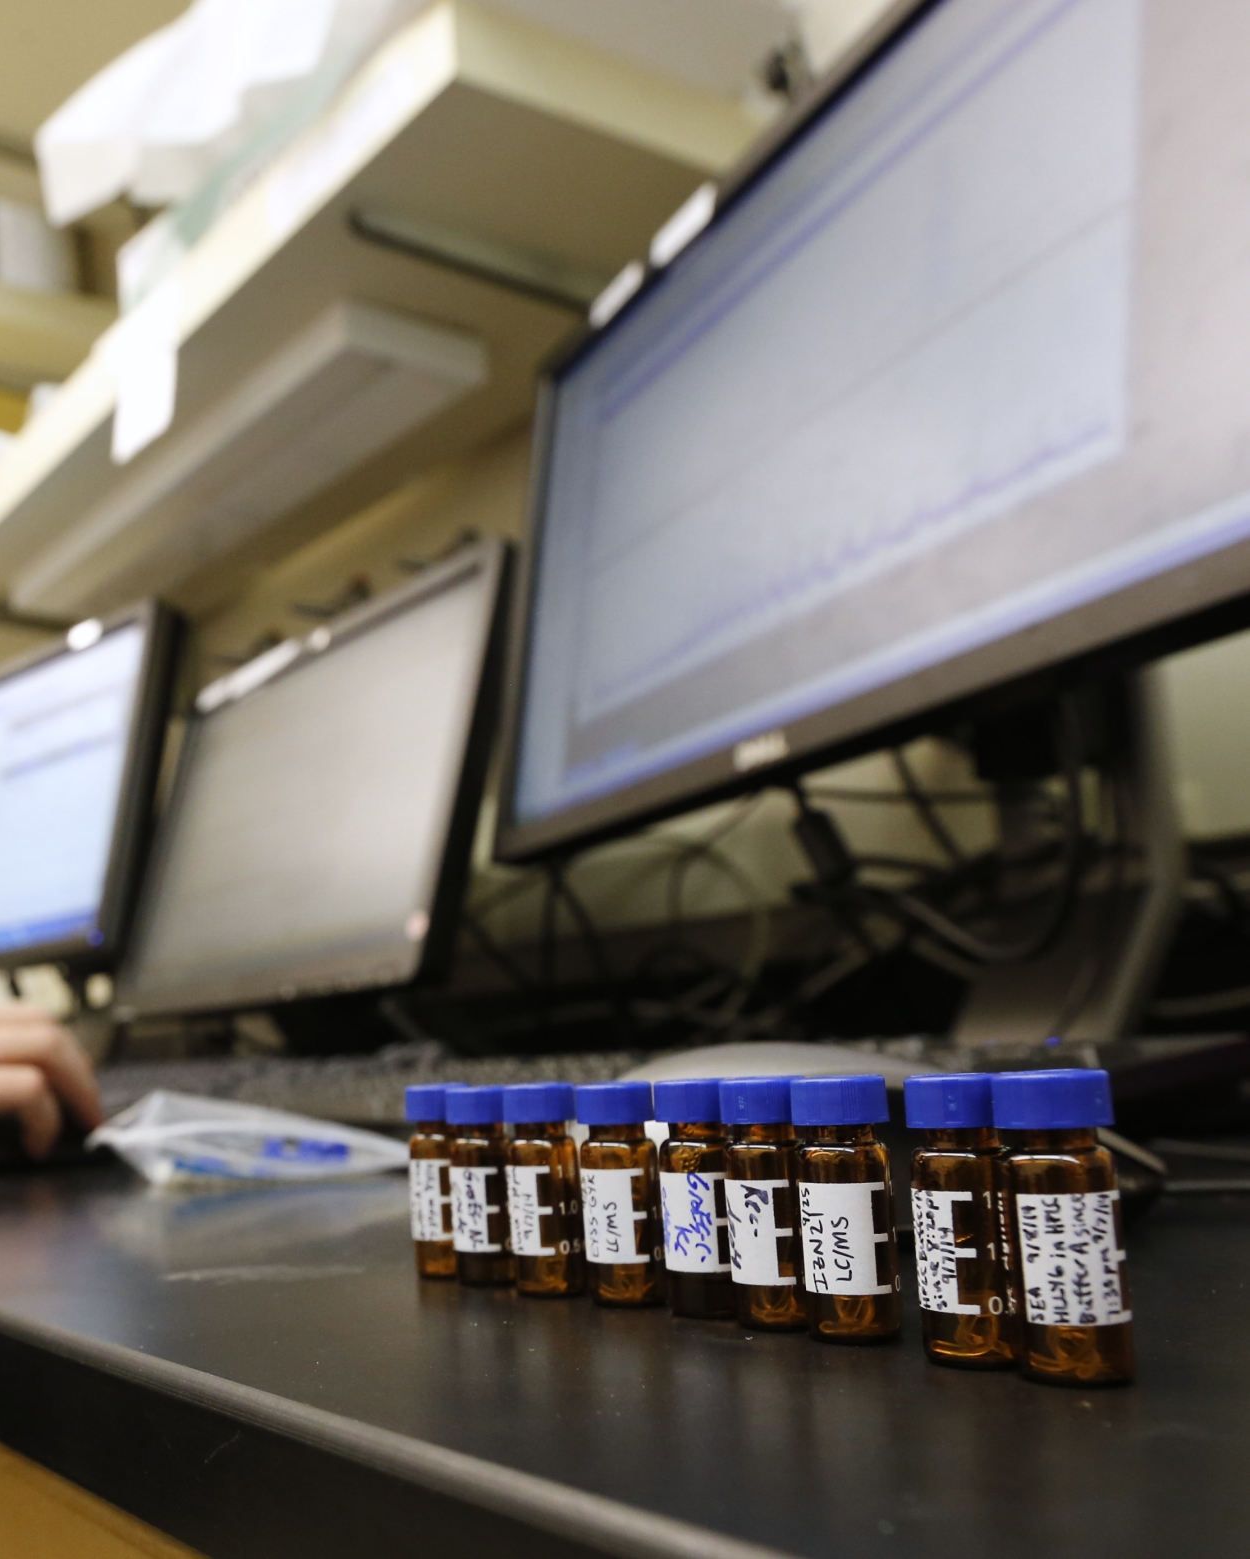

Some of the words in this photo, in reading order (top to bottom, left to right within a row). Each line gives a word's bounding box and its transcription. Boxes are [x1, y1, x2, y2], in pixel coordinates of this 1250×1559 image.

[603, 1201, 622, 1253] LC/MS
[1021, 1205, 1040, 1263] 9/8/14
[1040, 1197, 1065, 1234] HPLC
[1070, 1193, 1091, 1237] since
[830, 1216, 855, 1282] LC/MS
[937, 1227, 957, 1284] 9/7/14
[1049, 1241, 1067, 1258] in
[1068, 1241, 1090, 1255] A
[1026, 1286, 1046, 1322] SEA
[1072, 1258, 1098, 1323] Buffer
